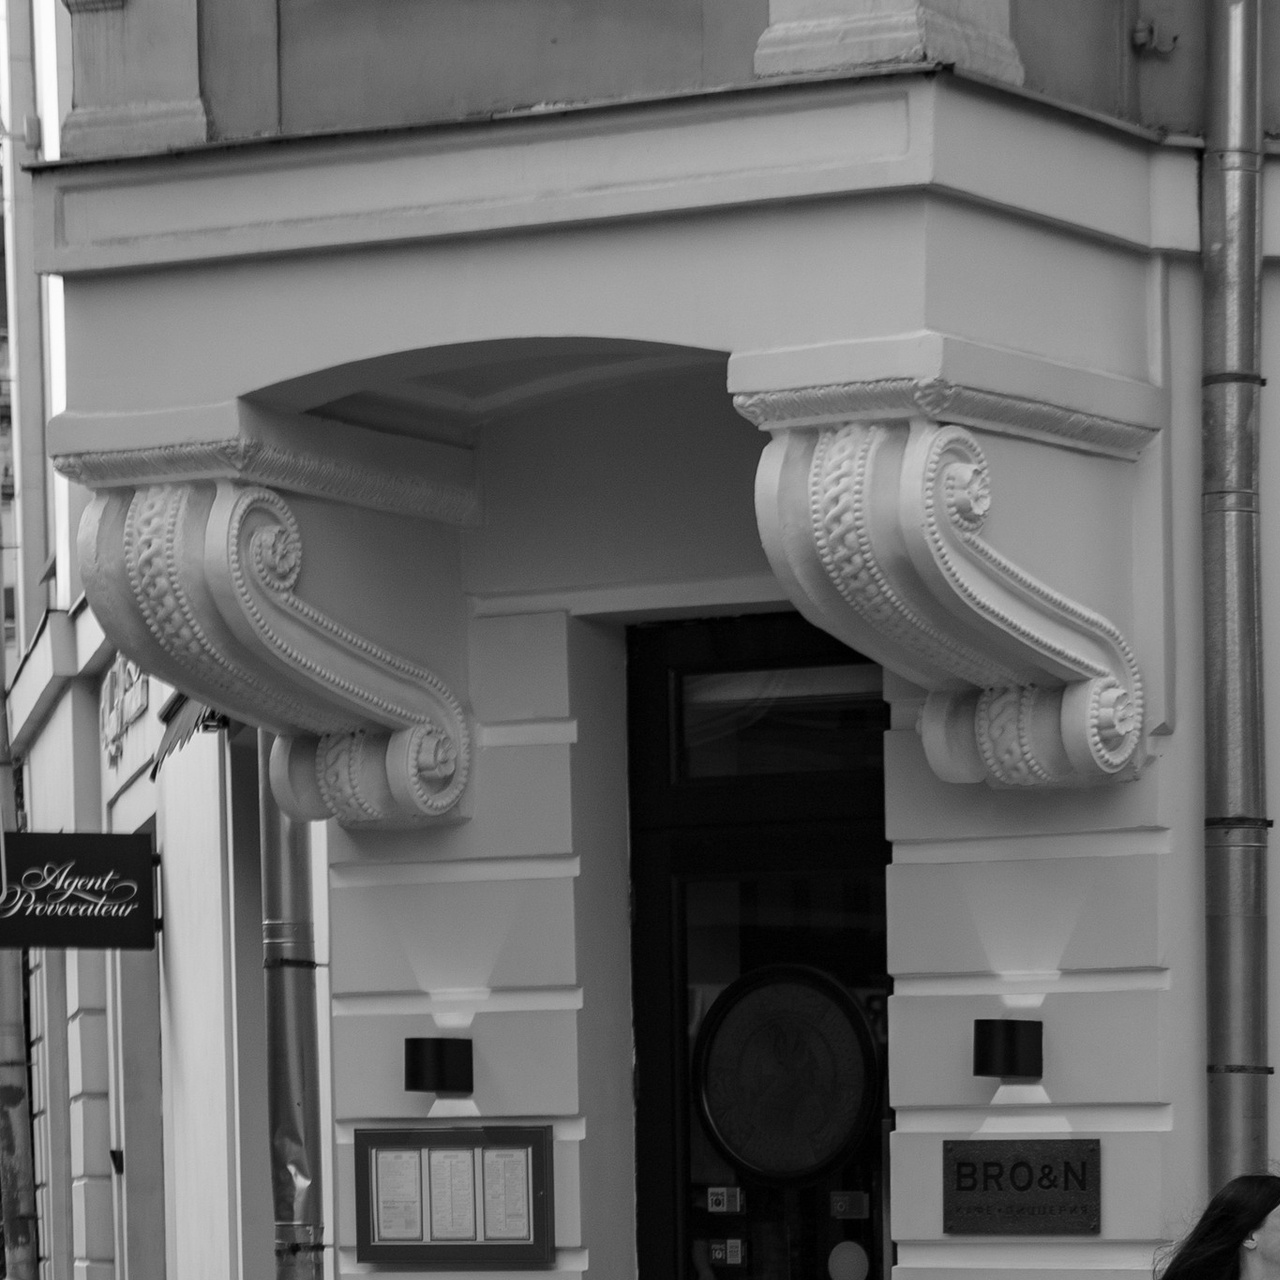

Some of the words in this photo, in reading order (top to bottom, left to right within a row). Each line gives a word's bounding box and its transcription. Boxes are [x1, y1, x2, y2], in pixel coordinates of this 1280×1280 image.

[21, 859, 138, 904] Agent
[0, 884, 139, 919] Provocateur
[955, 1160, 1087, 1192] BRO&N
